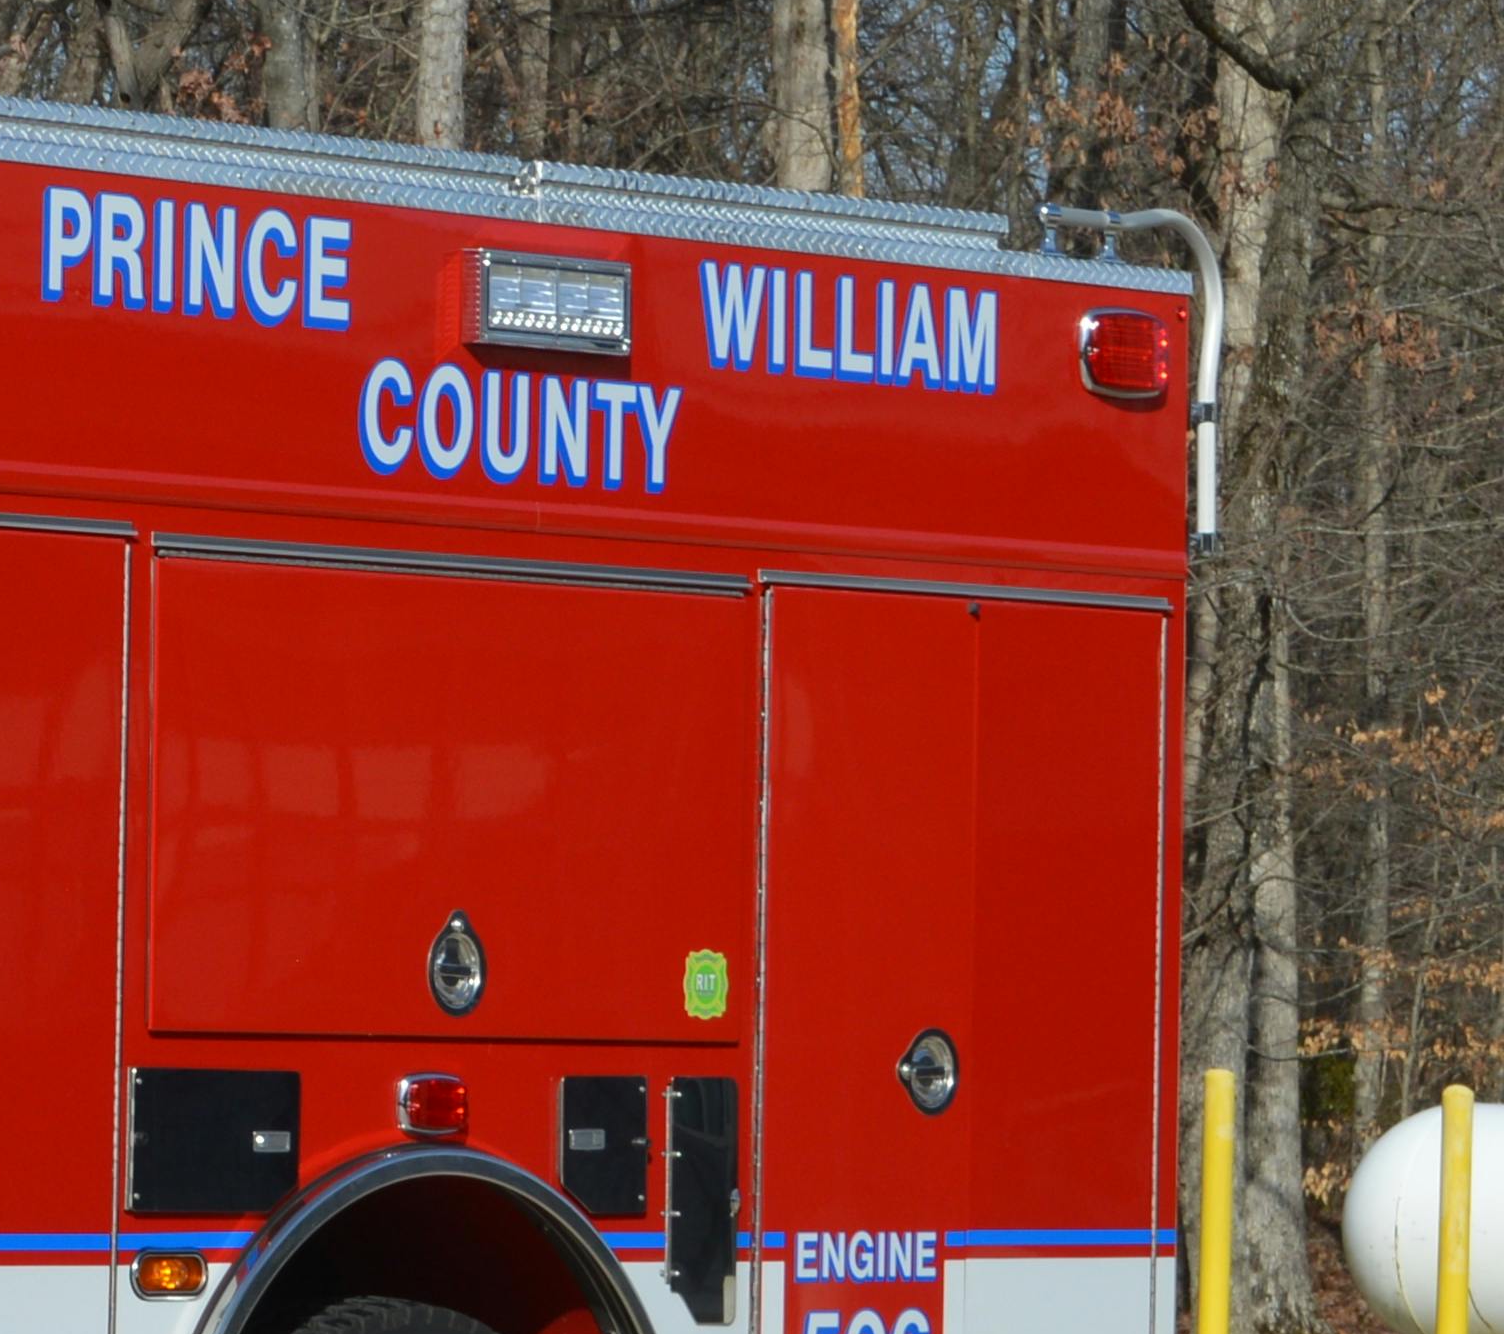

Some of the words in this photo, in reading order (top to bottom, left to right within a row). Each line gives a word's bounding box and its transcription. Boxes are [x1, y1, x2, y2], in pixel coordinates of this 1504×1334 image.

[41, 184, 352, 331] PRINCE
[699, 259, 999, 395] WILLIAM
[358, 357, 683, 494] COUNTY
[695, 973, 716, 991] RIT
[795, 1230, 938, 1284] ENGINE
